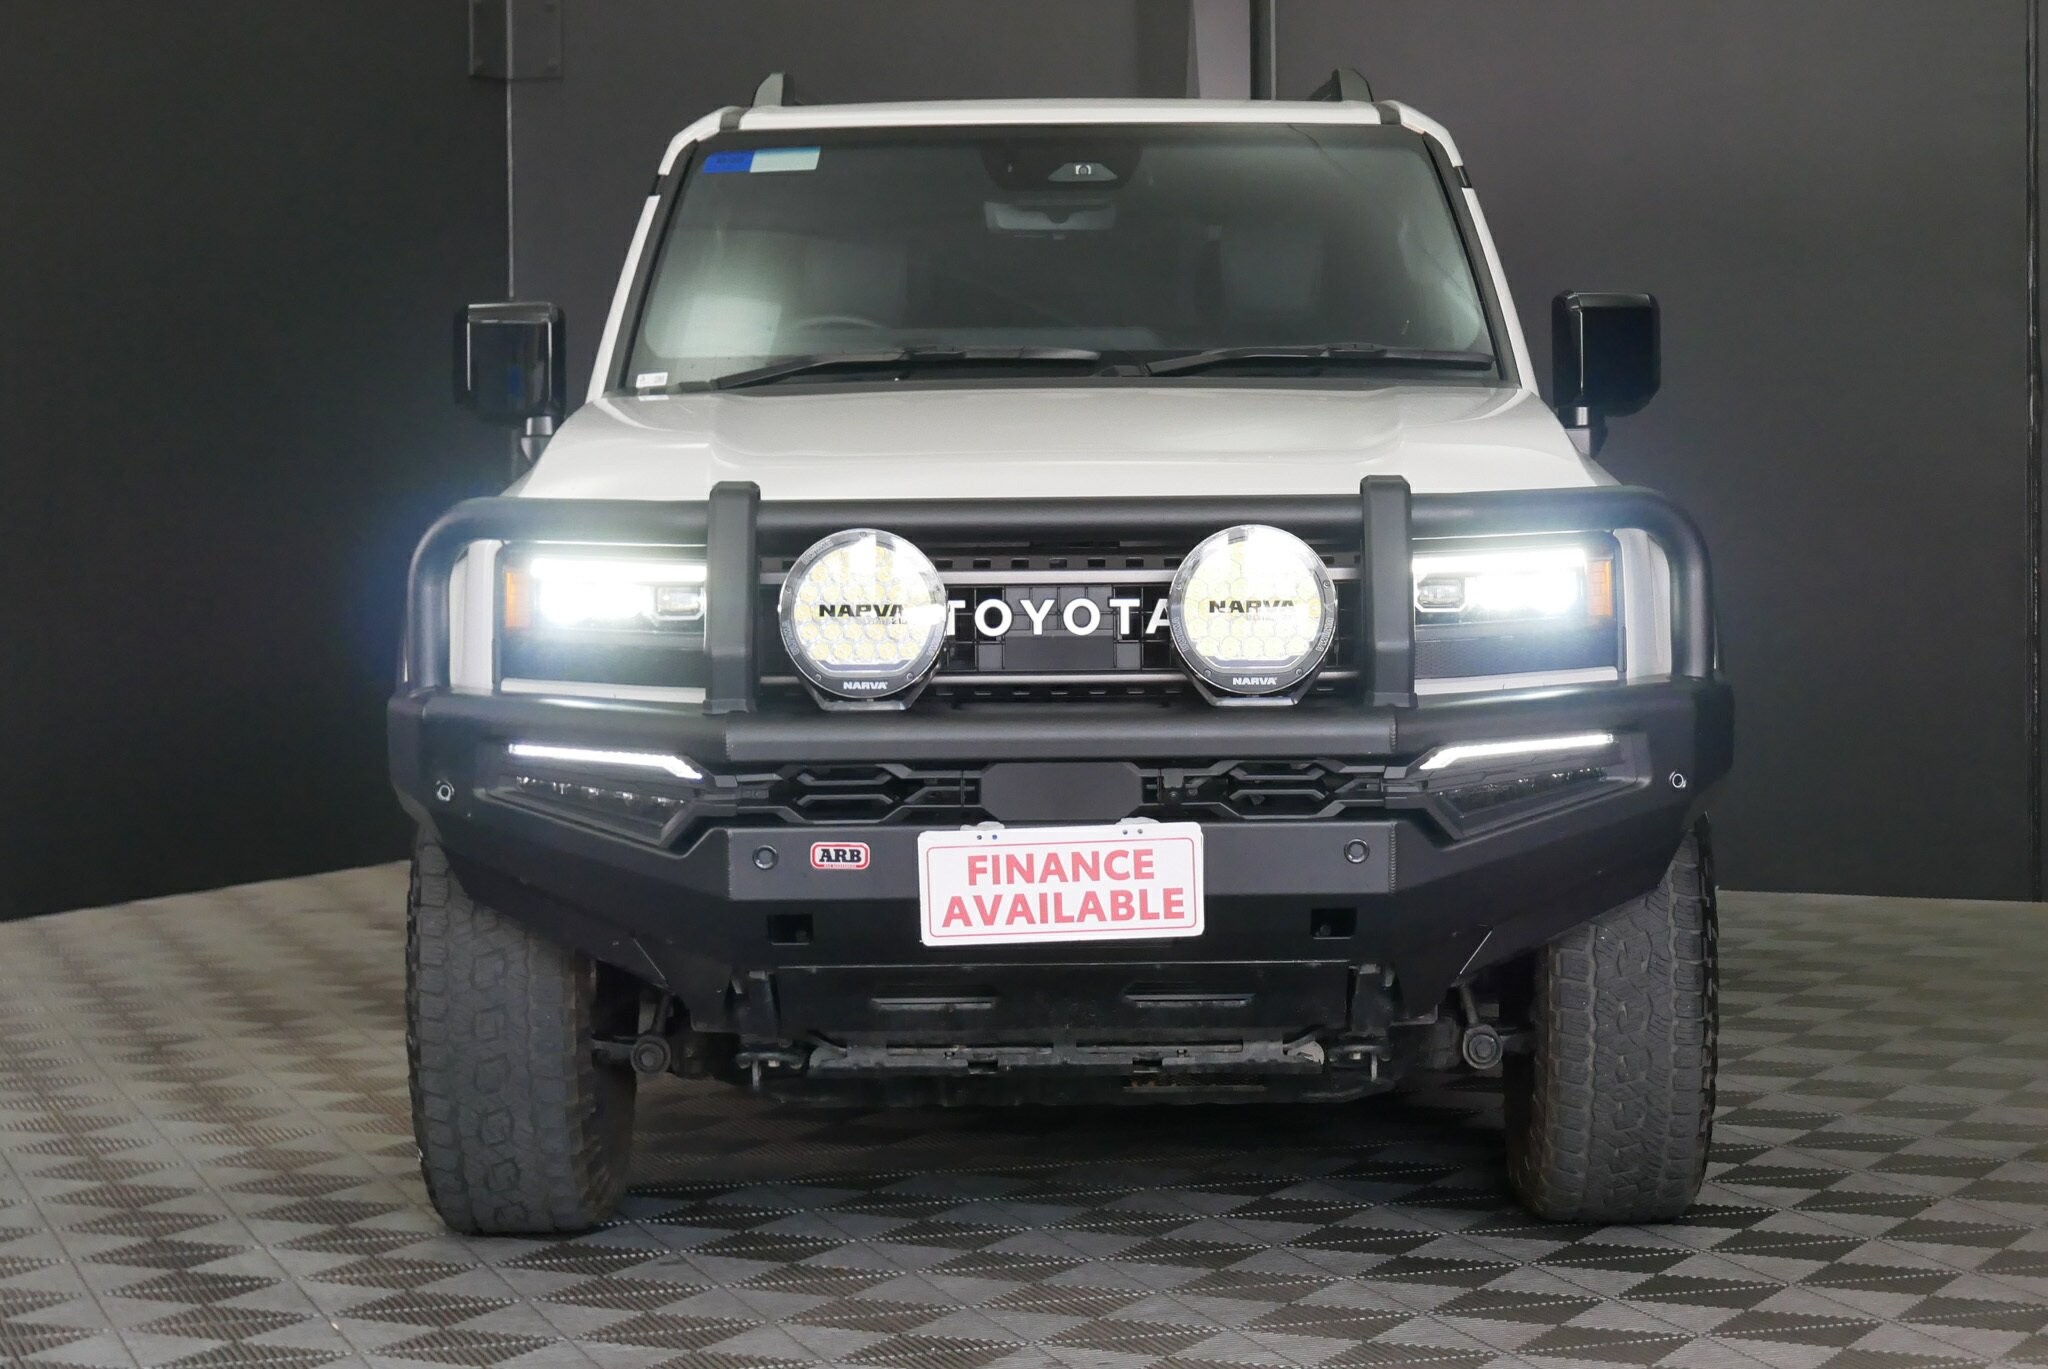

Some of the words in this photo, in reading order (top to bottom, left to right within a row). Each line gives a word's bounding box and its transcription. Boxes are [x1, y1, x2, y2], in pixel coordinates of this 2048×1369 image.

[946, 598, 1170, 637] TOYOTA
[843, 681, 888, 690] NARVA
[1232, 677, 1277, 685] NARVA
[819, 848, 862, 863] ARB
[968, 848, 1155, 886] FINANCE
[942, 887, 1185, 928] AVAILABLE
